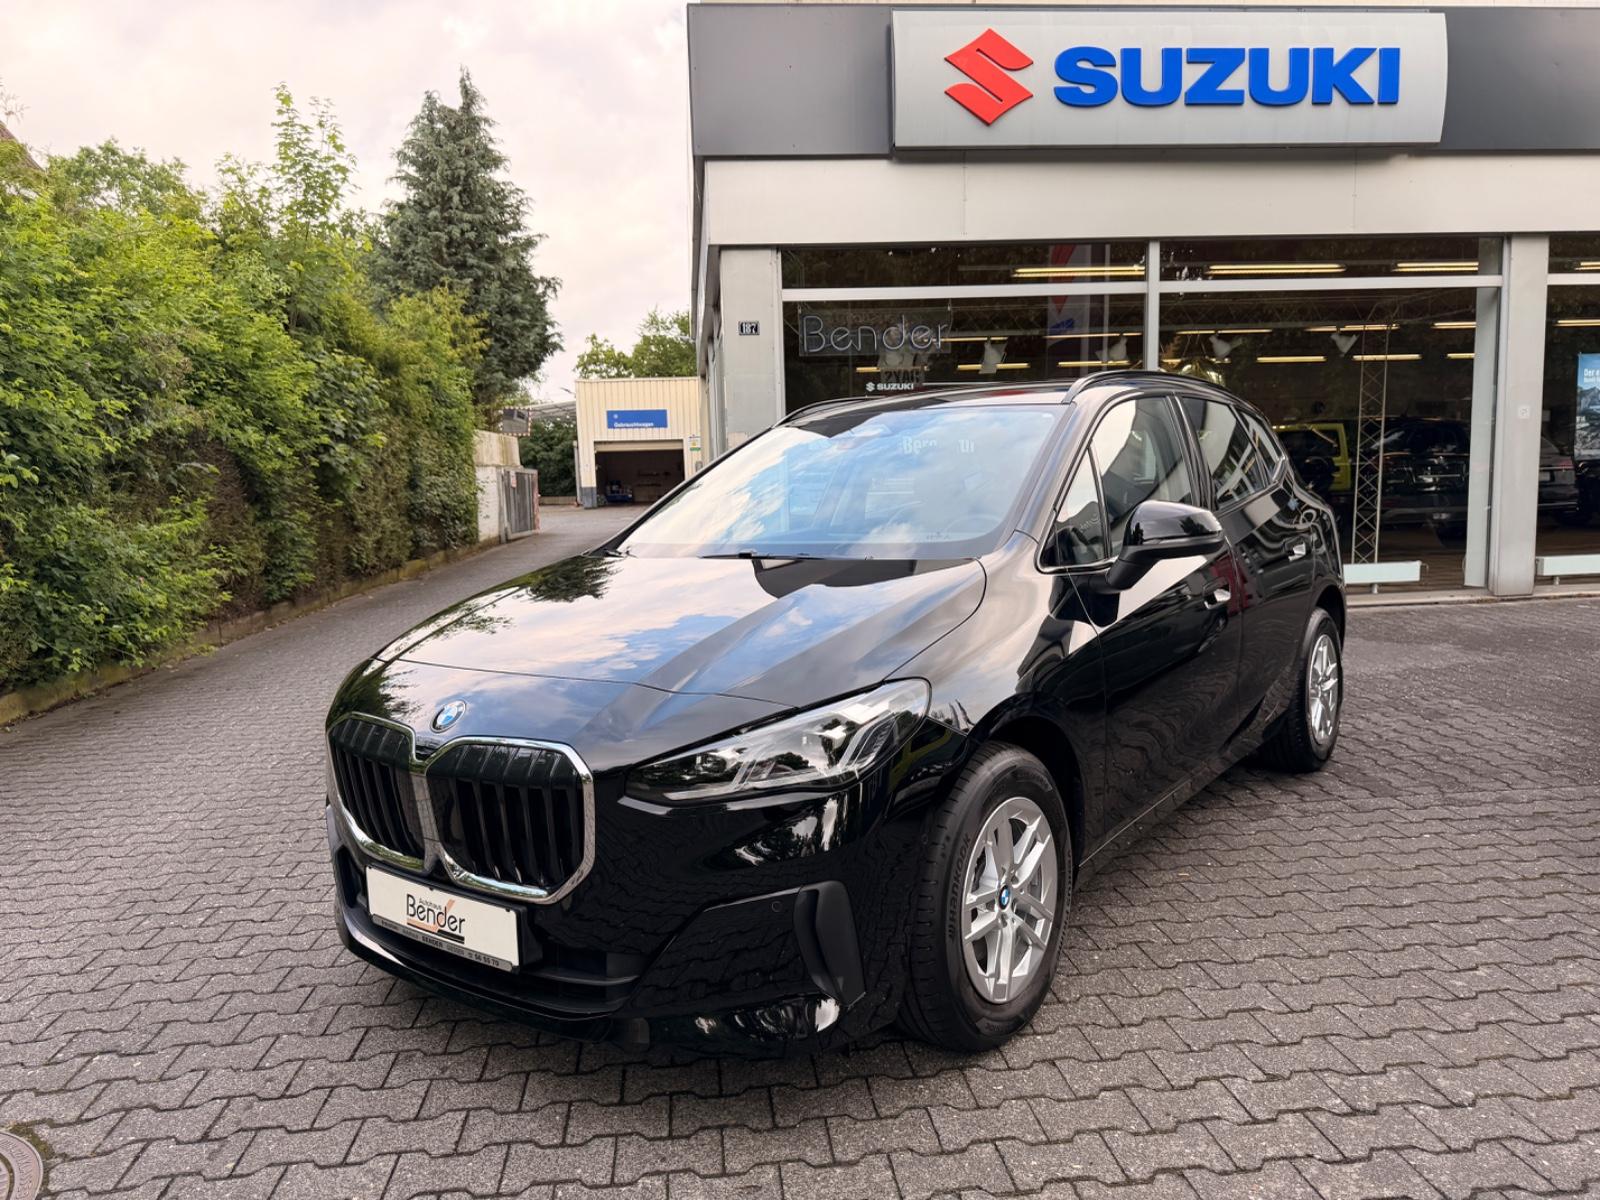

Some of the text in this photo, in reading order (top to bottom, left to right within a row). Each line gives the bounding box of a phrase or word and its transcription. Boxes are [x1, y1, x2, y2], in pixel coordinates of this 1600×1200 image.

[1053, 46, 1401, 107] SUZUKI
[742, 323, 756, 335] 187
[803, 314, 949, 353] Bender
[877, 383, 914, 391] SUZUKI
[406, 893, 466, 934] Bender
